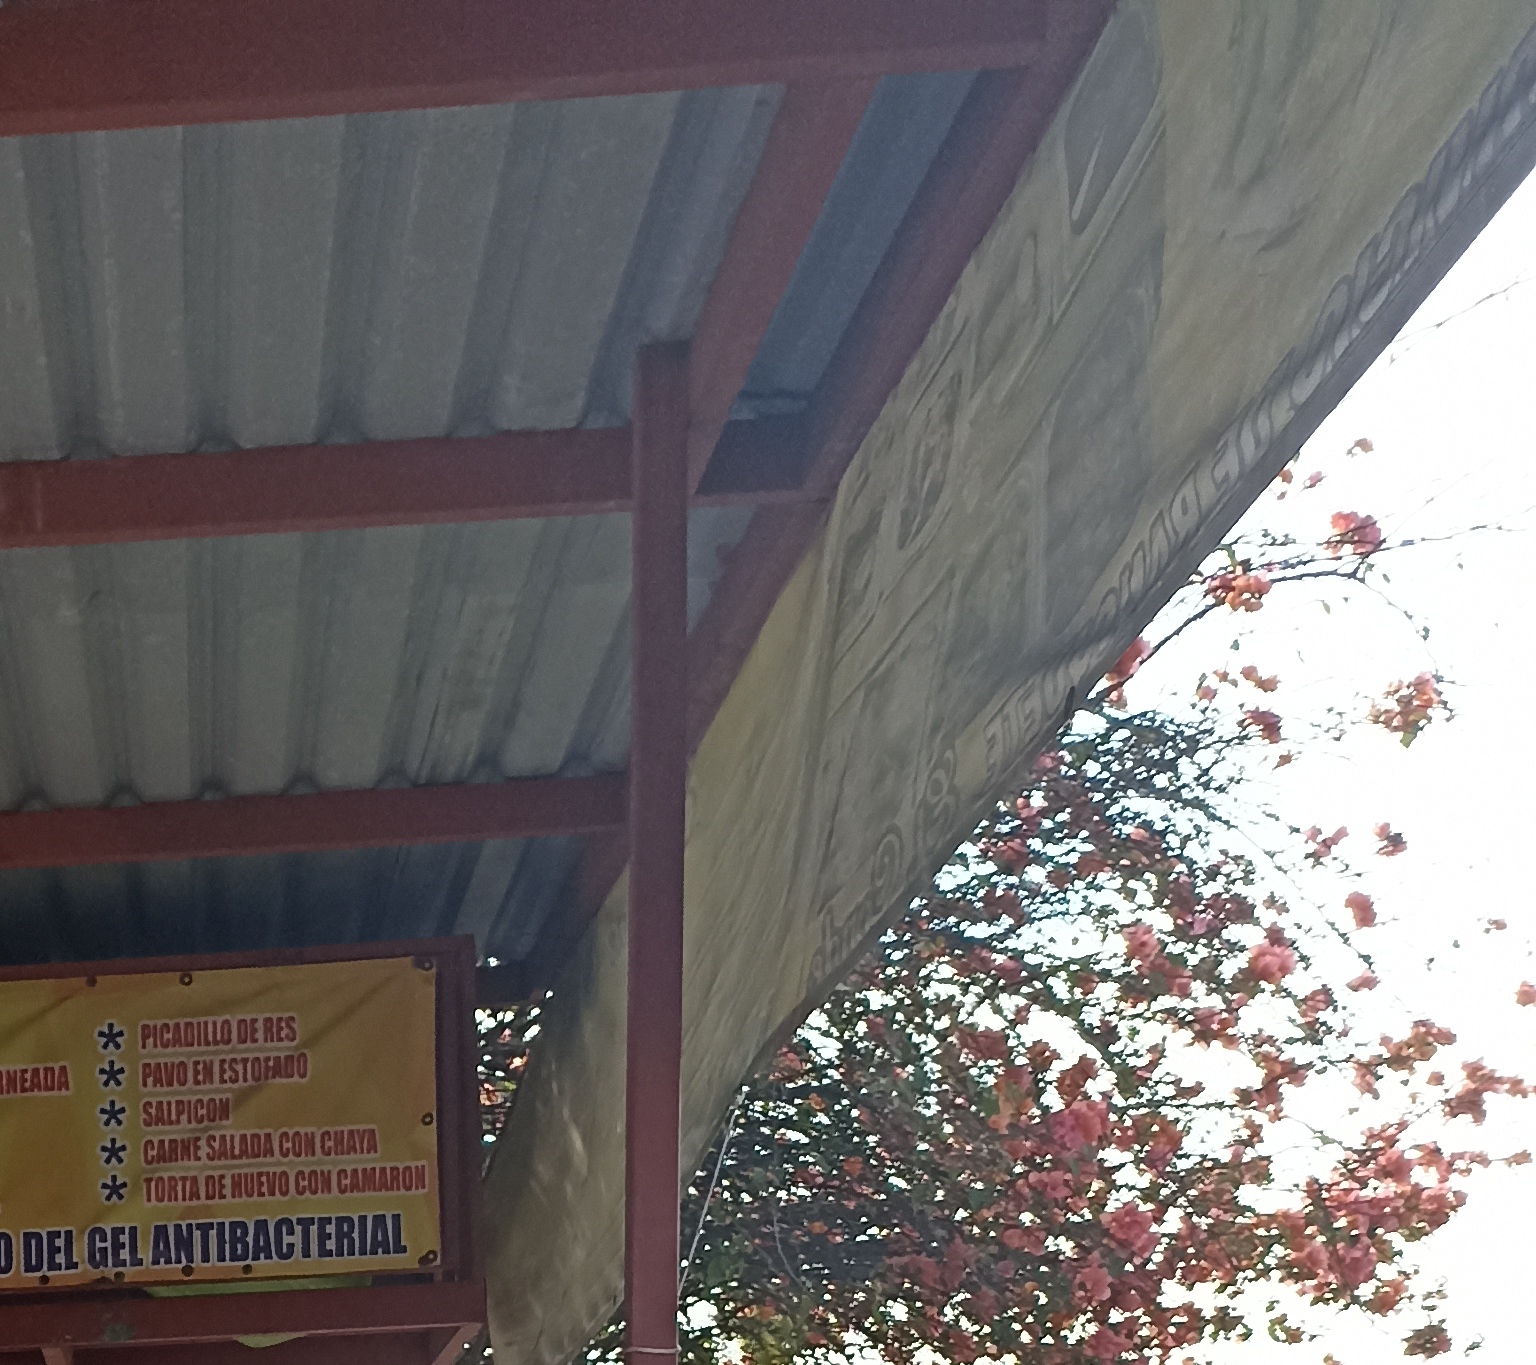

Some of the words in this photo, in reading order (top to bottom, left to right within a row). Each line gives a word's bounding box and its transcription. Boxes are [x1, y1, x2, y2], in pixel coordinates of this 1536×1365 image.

[140, 1019, 232, 1049] PICADILLO
[237, 1018, 259, 1044] DE
[263, 1015, 297, 1042] RES
[141, 1060, 188, 1088] PAVO
[193, 1059, 215, 1086] EN
[219, 1052, 308, 1084] ESTOFADO
[142, 1097, 231, 1127] SALPICON
[143, 1137, 202, 1166] CARNE
[206, 1132, 275, 1162] SALADA
[279, 1130, 316, 1159] CON
[321, 1128, 378, 1156] CHAYA
[144, 1175, 202, 1204] TORTA
[205, 1173, 227, 1200] DE
[231, 1171, 290, 1199] HUEVO
[295, 1168, 332, 1197] CON
[337, 1164, 426, 1194] CAMARON
[23, 1229, 79, 1273] DEL
[87, 1226, 143, 1269] GEL
[151, 1213, 408, 1266] ANTIBACTERIAL
